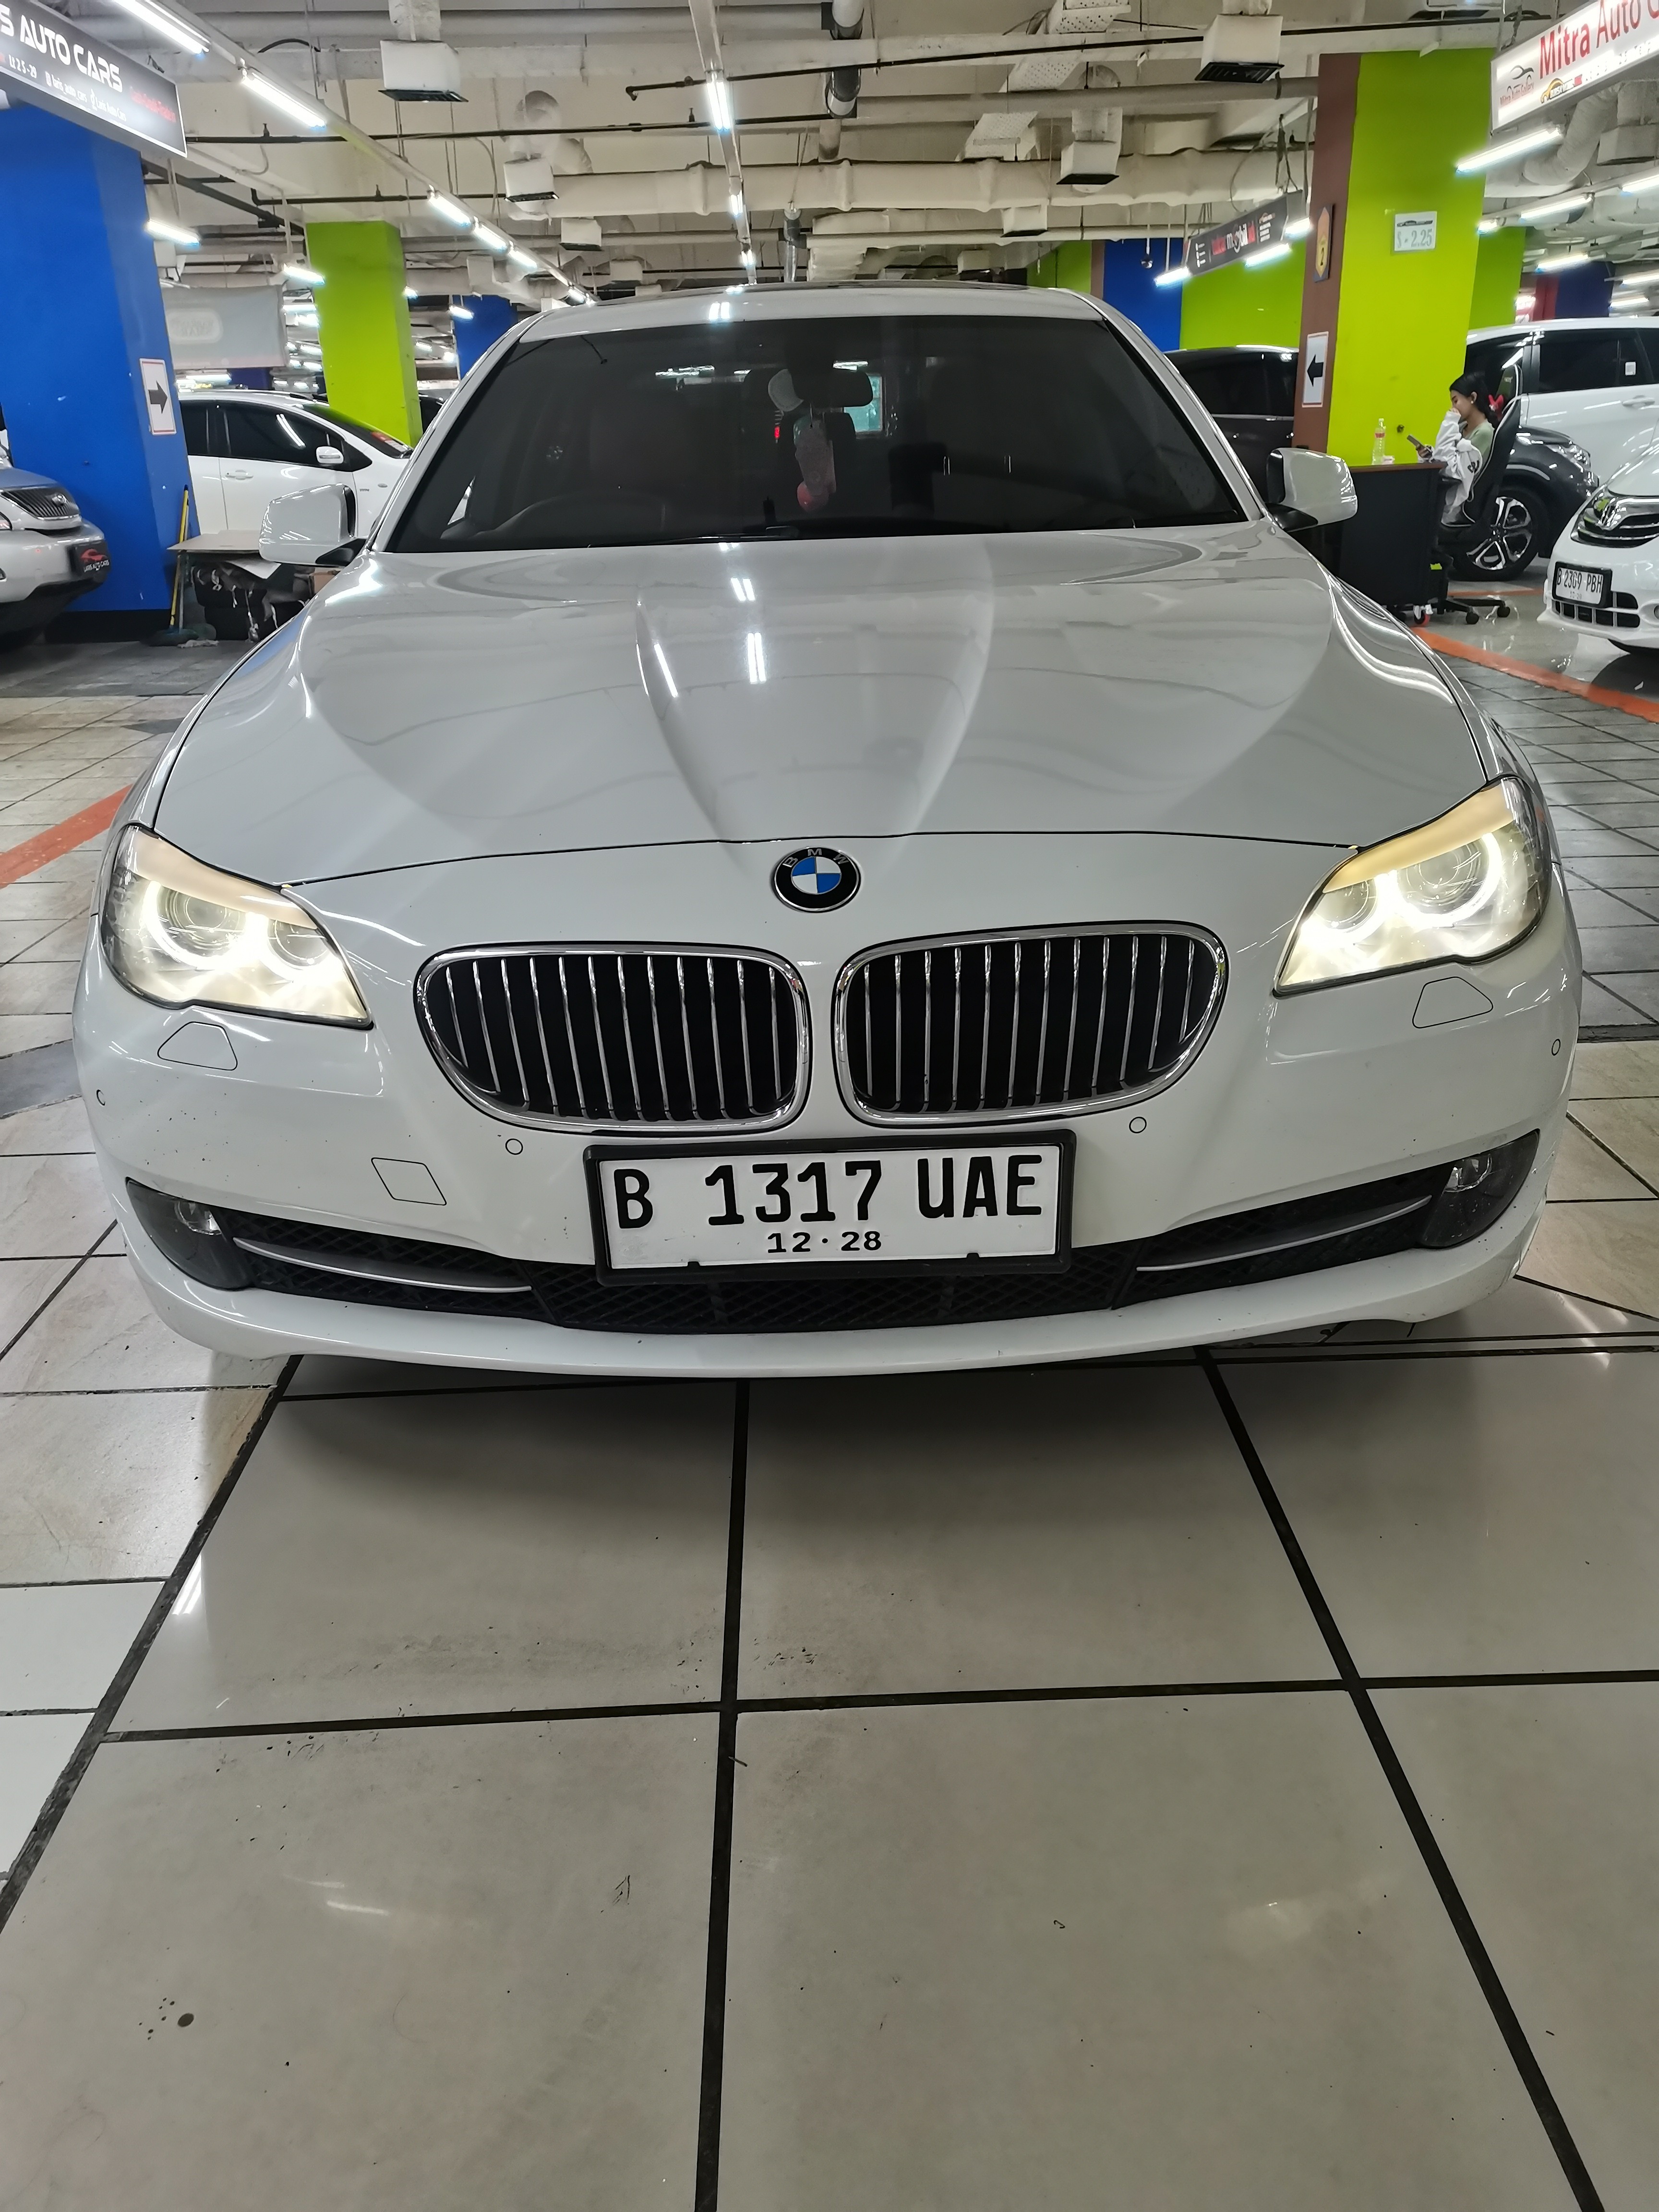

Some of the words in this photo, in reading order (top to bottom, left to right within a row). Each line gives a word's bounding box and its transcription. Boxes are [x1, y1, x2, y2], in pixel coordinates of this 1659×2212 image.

[20, 14, 71, 65] AUTO
[73, 44, 123, 93] CARS
[1539, 24, 1590, 80] Mitra
[1596, 0, 1641, 48] Auto
[1556, 568, 1562, 586] B
[1586, 573, 1603, 594] PBH
[782, 848, 849, 868] BMW
[613, 1168, 654, 1229] B
[704, 1159, 882, 1226] 1317
[917, 1154, 1043, 1219] UAE
